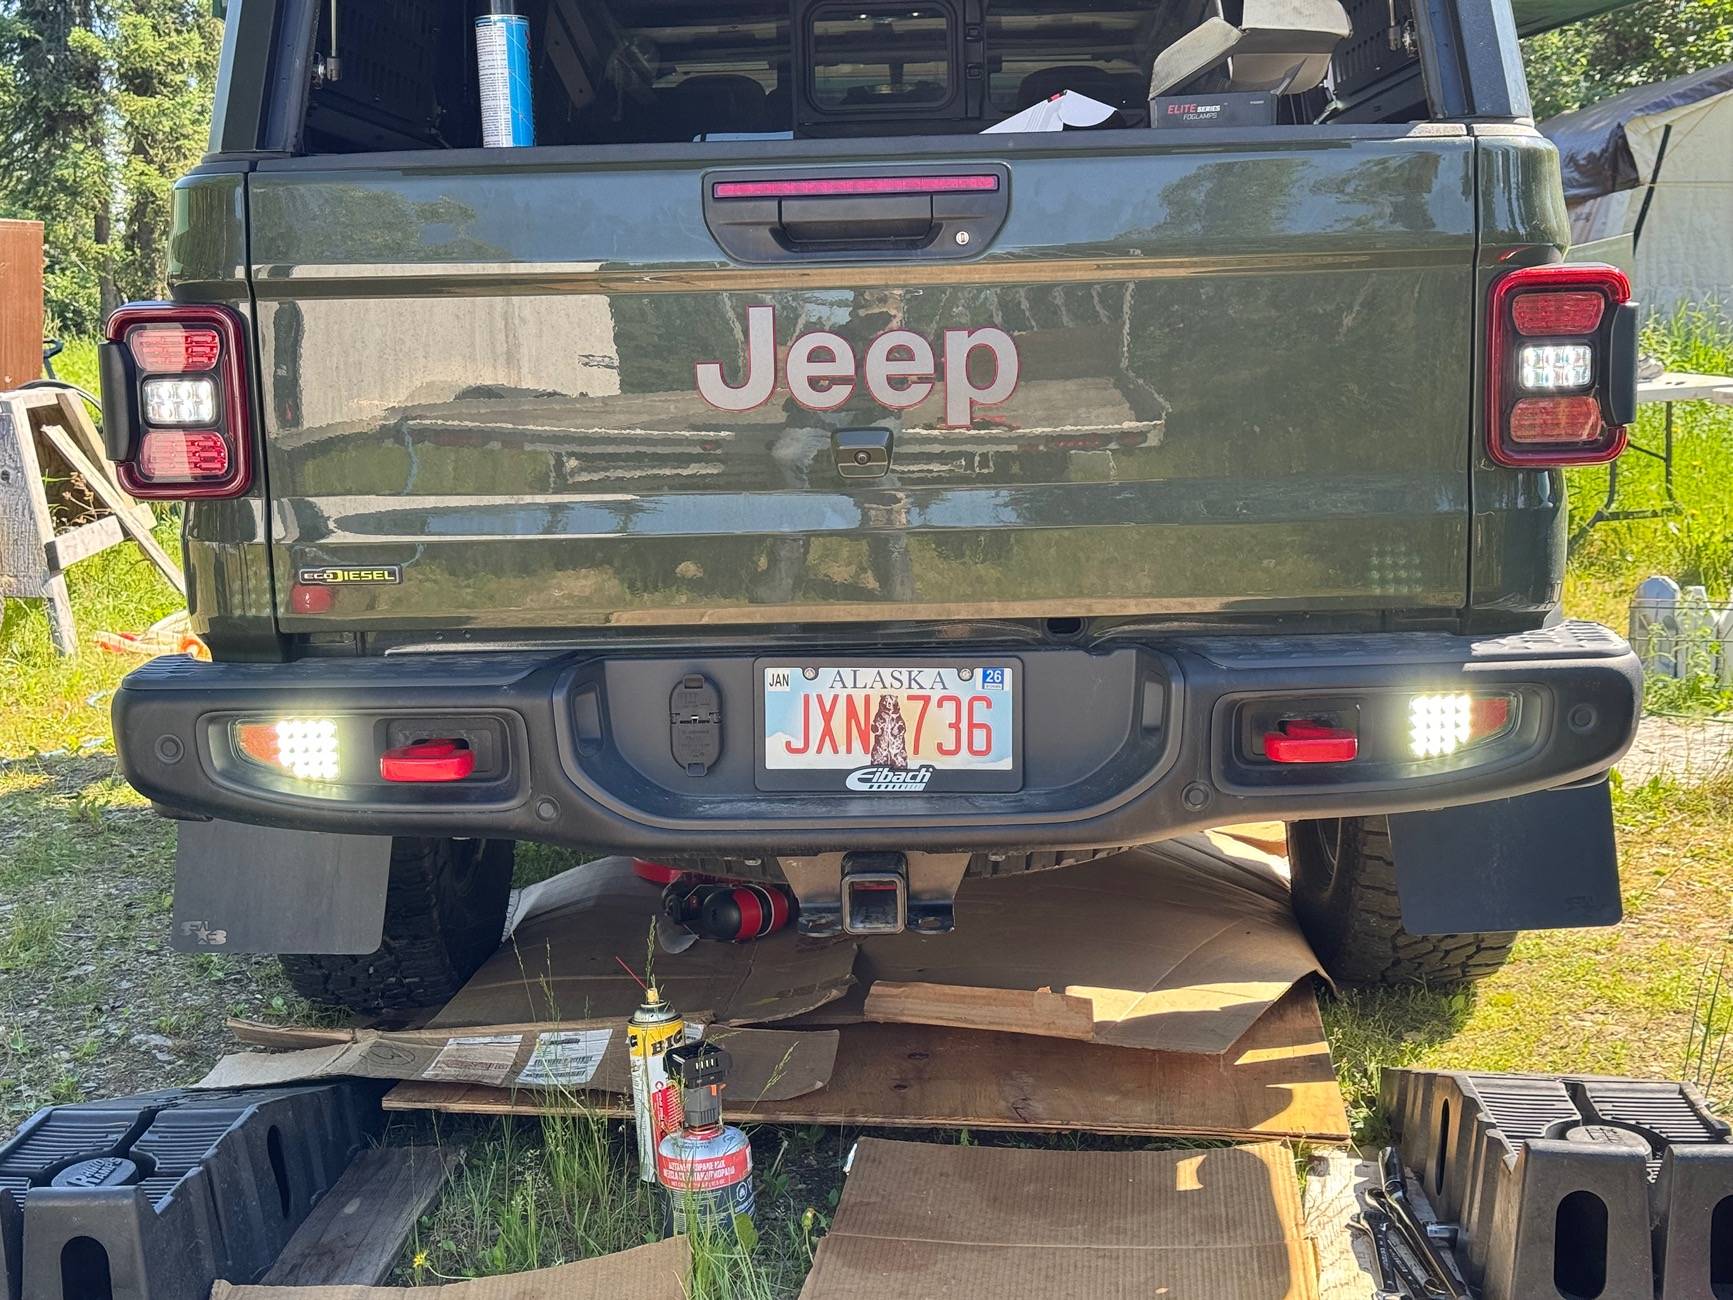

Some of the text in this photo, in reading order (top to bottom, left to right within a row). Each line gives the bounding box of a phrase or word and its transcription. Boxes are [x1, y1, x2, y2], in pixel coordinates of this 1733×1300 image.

[1167, 104, 1220, 114] ELITE SERIES
[1183, 112, 1217, 120] FOGLAMPS
[695, 304, 1020, 429] Jeep
[768, 673, 790, 688] JAN
[828, 669, 949, 690] ALASKA
[985, 670, 1002, 683] 26
[785, 694, 993, 757] JXN 736
[845, 767, 933, 791] Eibach
